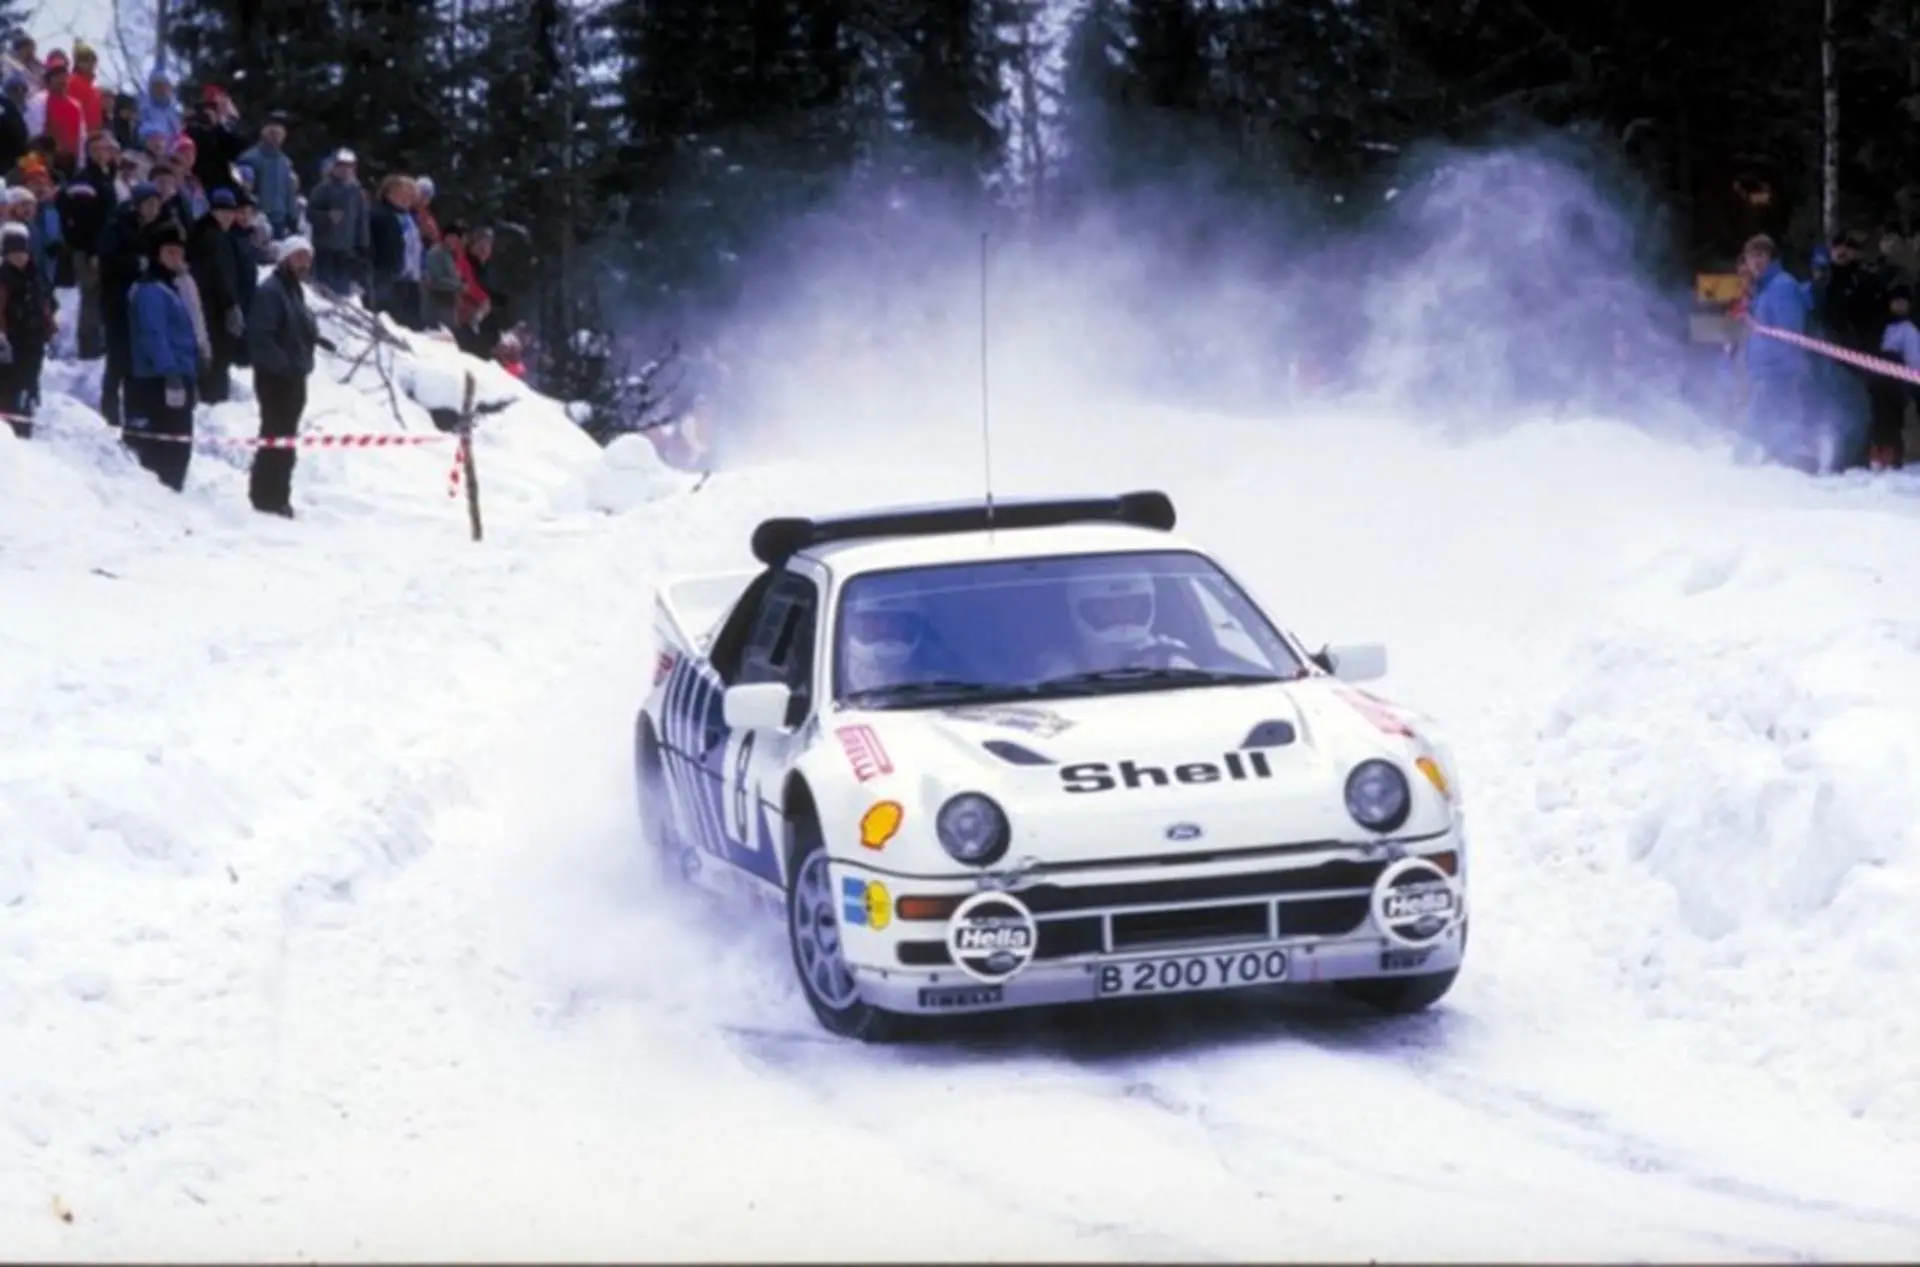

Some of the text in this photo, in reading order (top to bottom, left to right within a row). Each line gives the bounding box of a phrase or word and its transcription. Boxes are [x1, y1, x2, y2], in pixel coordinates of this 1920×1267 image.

[1059, 752, 1272, 793] Shell
[962, 928, 1026, 948] Hella
[1102, 965, 1122, 992] B
[1134, 959, 1207, 991] 200
